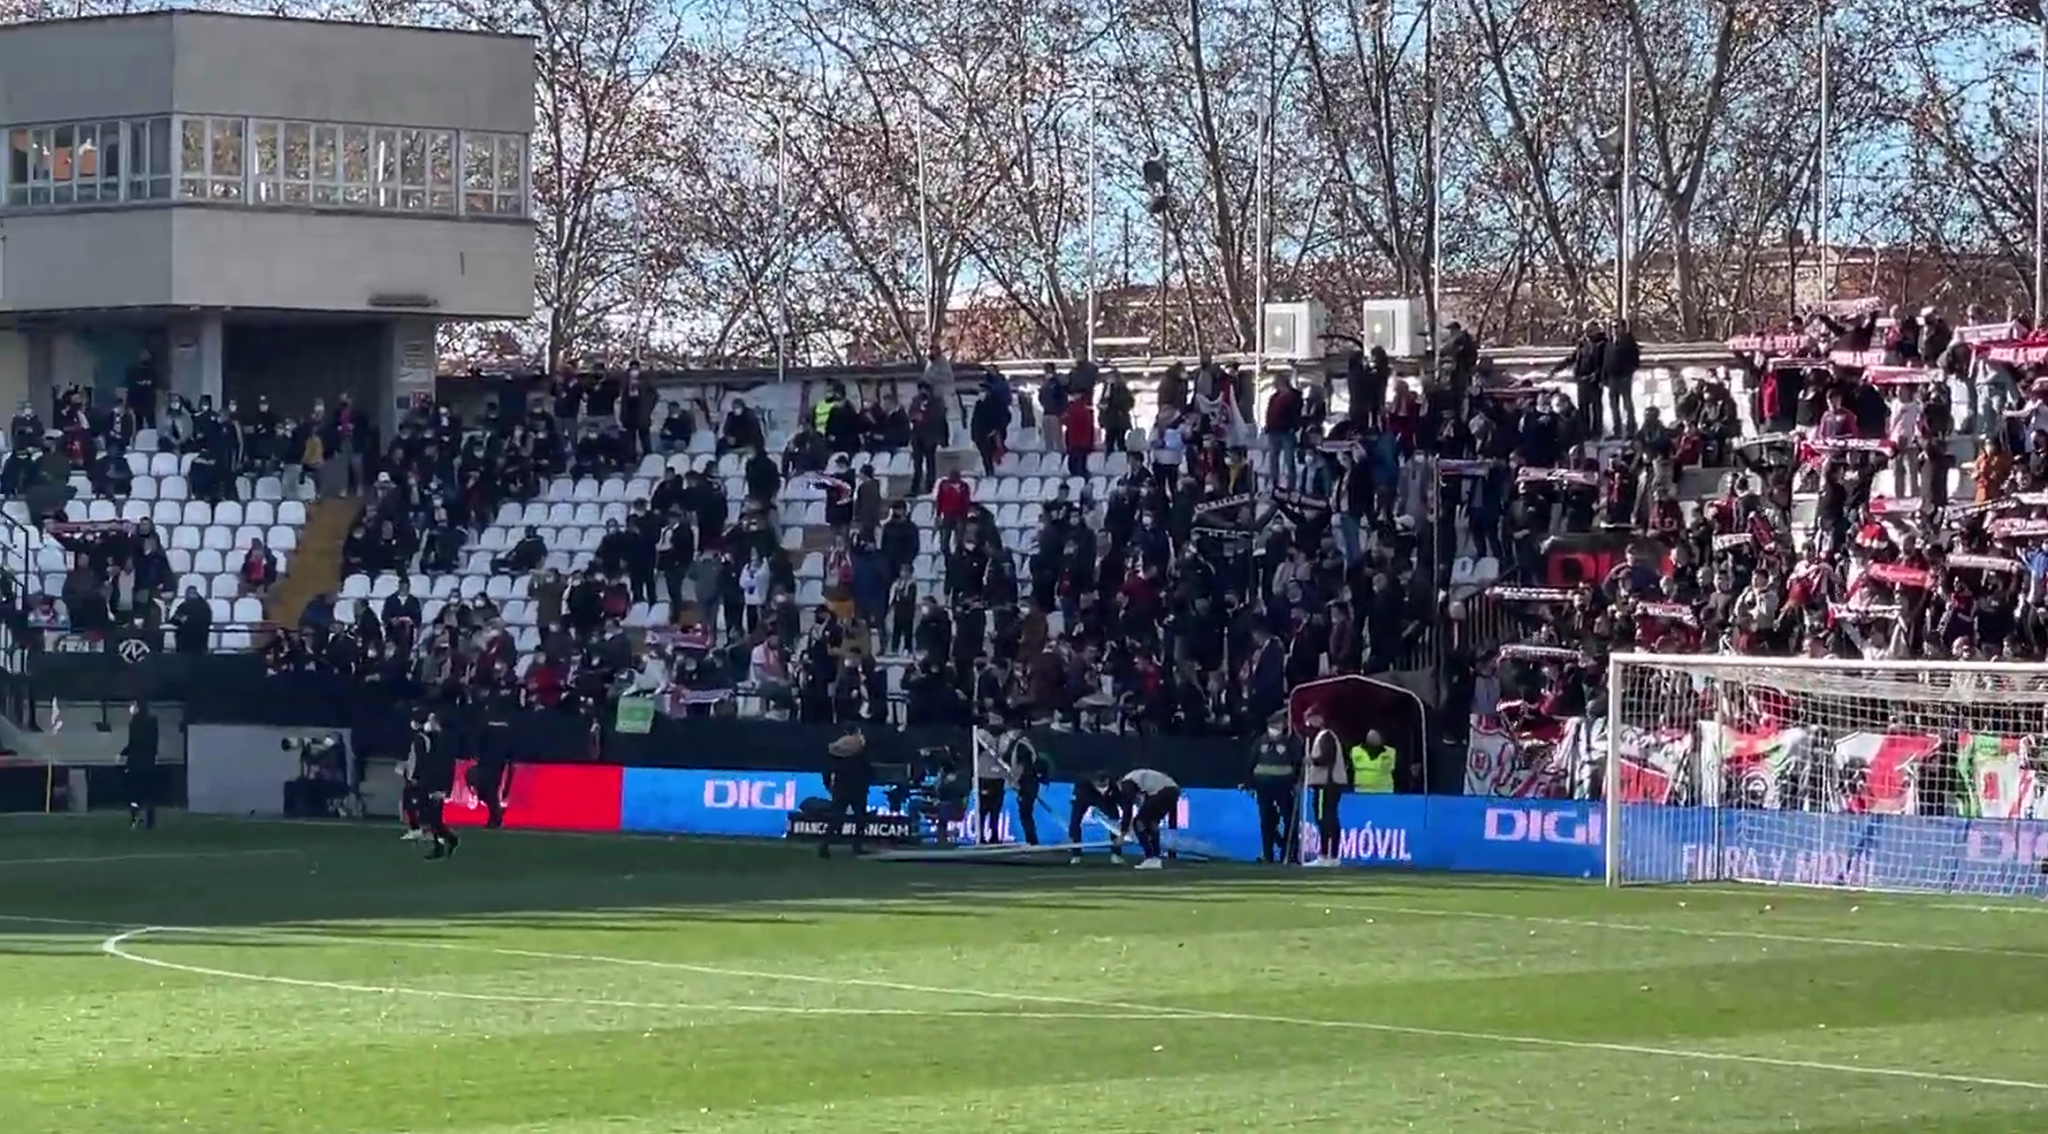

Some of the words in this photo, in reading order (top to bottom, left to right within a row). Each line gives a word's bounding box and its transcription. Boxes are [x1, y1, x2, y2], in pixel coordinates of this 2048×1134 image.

[704, 778, 796, 811] DIGI
[1338, 820, 1412, 860] MÓVIL
[1484, 807, 1601, 846] DIGI
